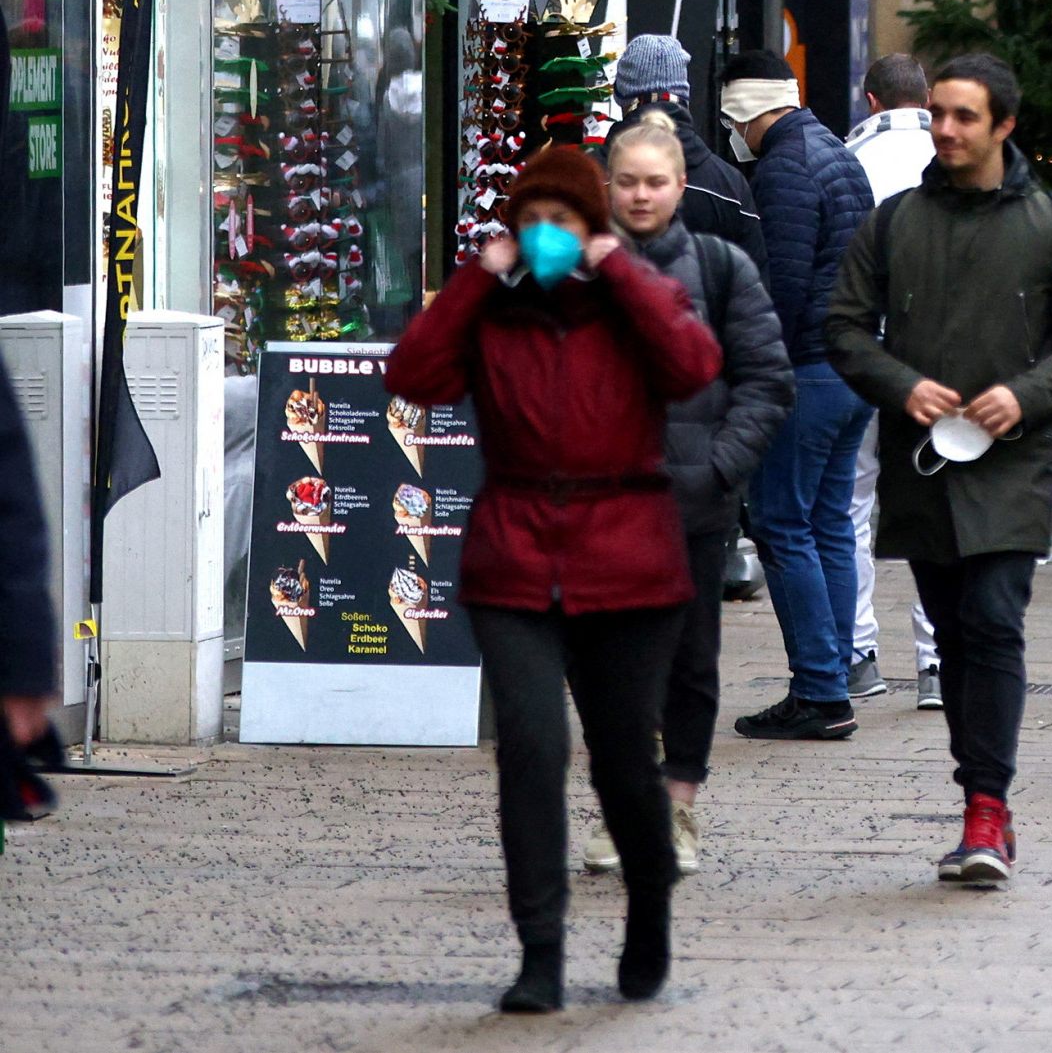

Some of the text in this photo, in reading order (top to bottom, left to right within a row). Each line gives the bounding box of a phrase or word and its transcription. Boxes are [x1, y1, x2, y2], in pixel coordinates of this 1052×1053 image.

[30, 123, 57, 172] STORE
[329, 409, 380, 417] Schokoladensoße
[329, 417, 365, 426] Schlagsahne
[431, 419, 467, 428] Schlagsahne
[328, 424, 356, 432] Keksrolle
[281, 431, 370, 444] Schokoladentraum
[405, 434, 475, 446] Bananatella
[334, 486, 356, 494] Nutella
[334, 501, 370, 509] Schlagsahne
[277, 522, 346, 534] Erdbeerwunder
[319, 593, 355, 601] Schlagsahne
[341, 612, 371, 621] Soßen:
[352, 623, 388, 633] Schoko
[350, 634, 388, 643] Erdbeer
[347, 645, 387, 654] Karamel
